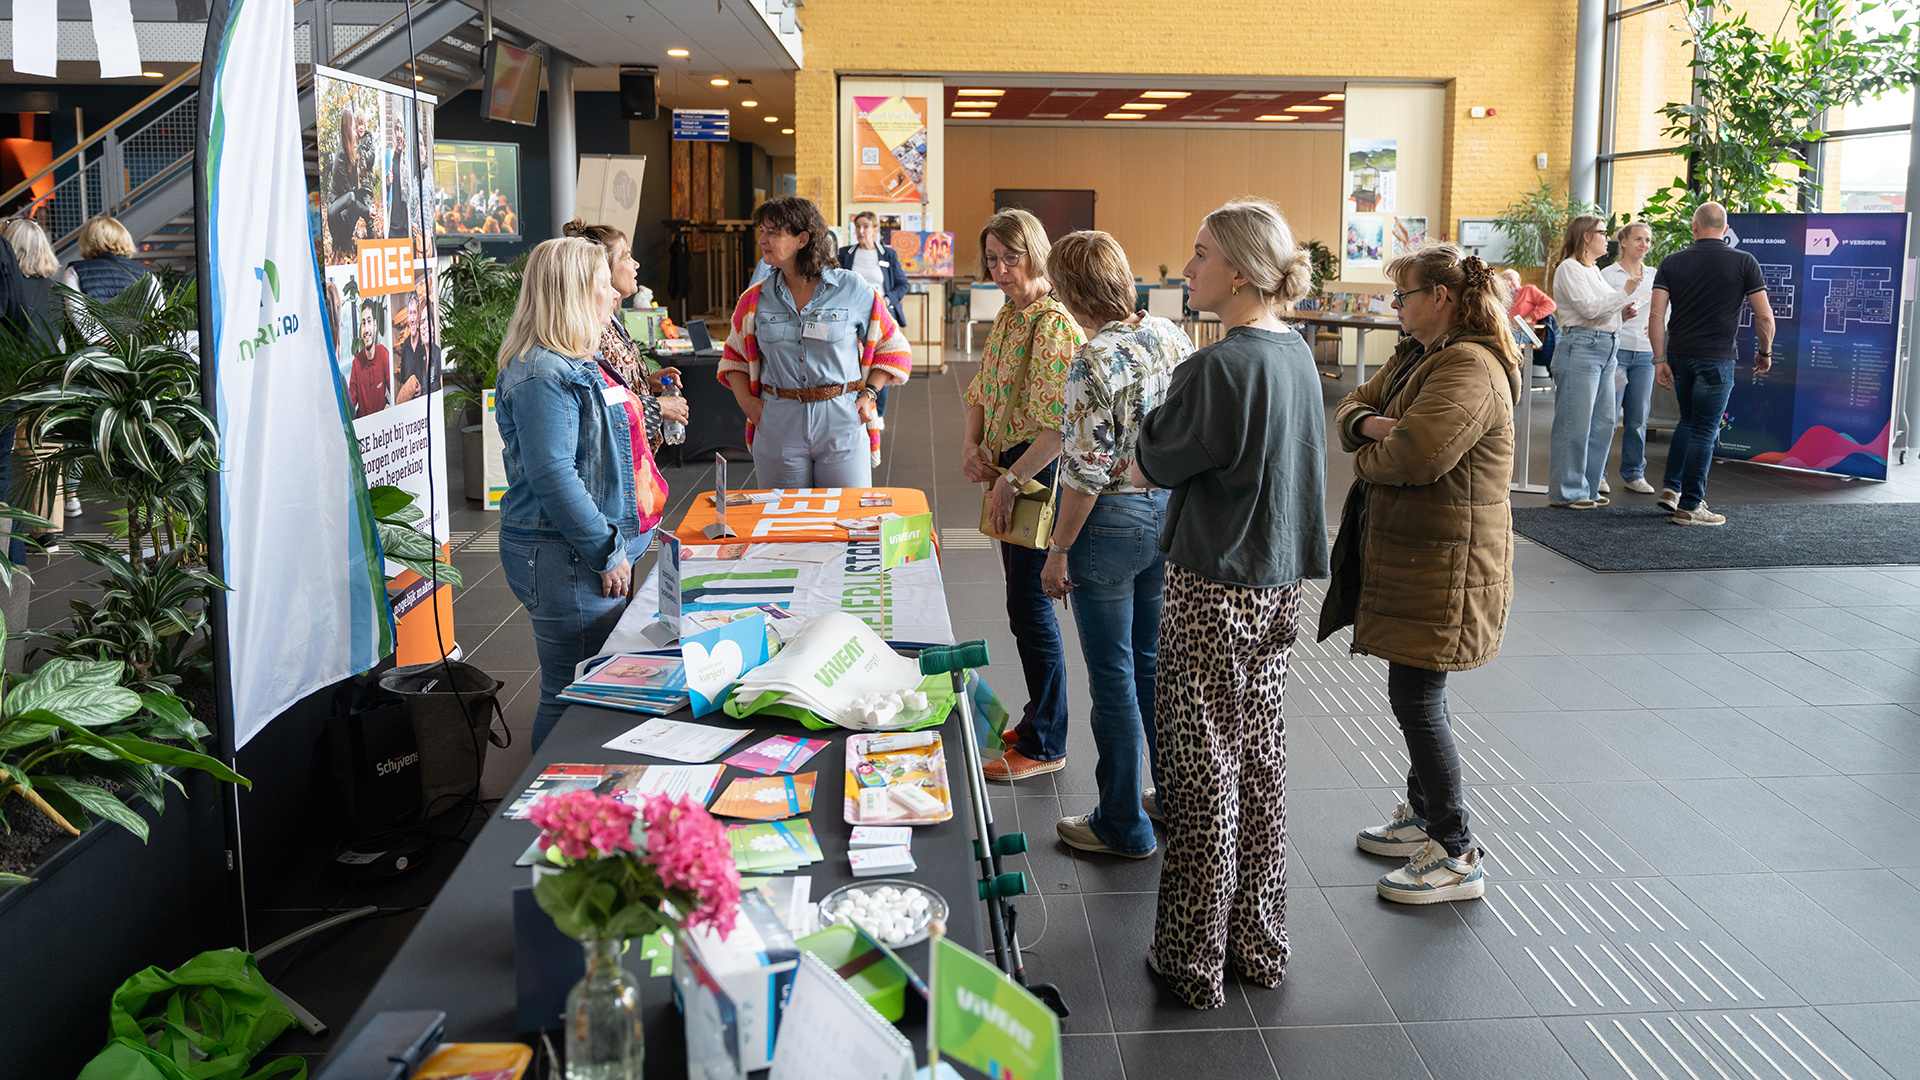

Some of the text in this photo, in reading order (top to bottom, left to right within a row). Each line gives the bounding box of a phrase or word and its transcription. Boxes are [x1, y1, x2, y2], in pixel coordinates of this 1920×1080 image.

[361, 246, 413, 290] MEE
[372, 426, 393, 452] helpt
[393, 421, 405, 443] bij
[390, 444, 408, 463] over
[409, 436, 428, 455] leven
[385, 458, 424, 487] beperking
[698, 666, 726, 683] kanjer!
[863, 653, 881, 673] zorgt!
[376, 751, 418, 776] Schijvens
